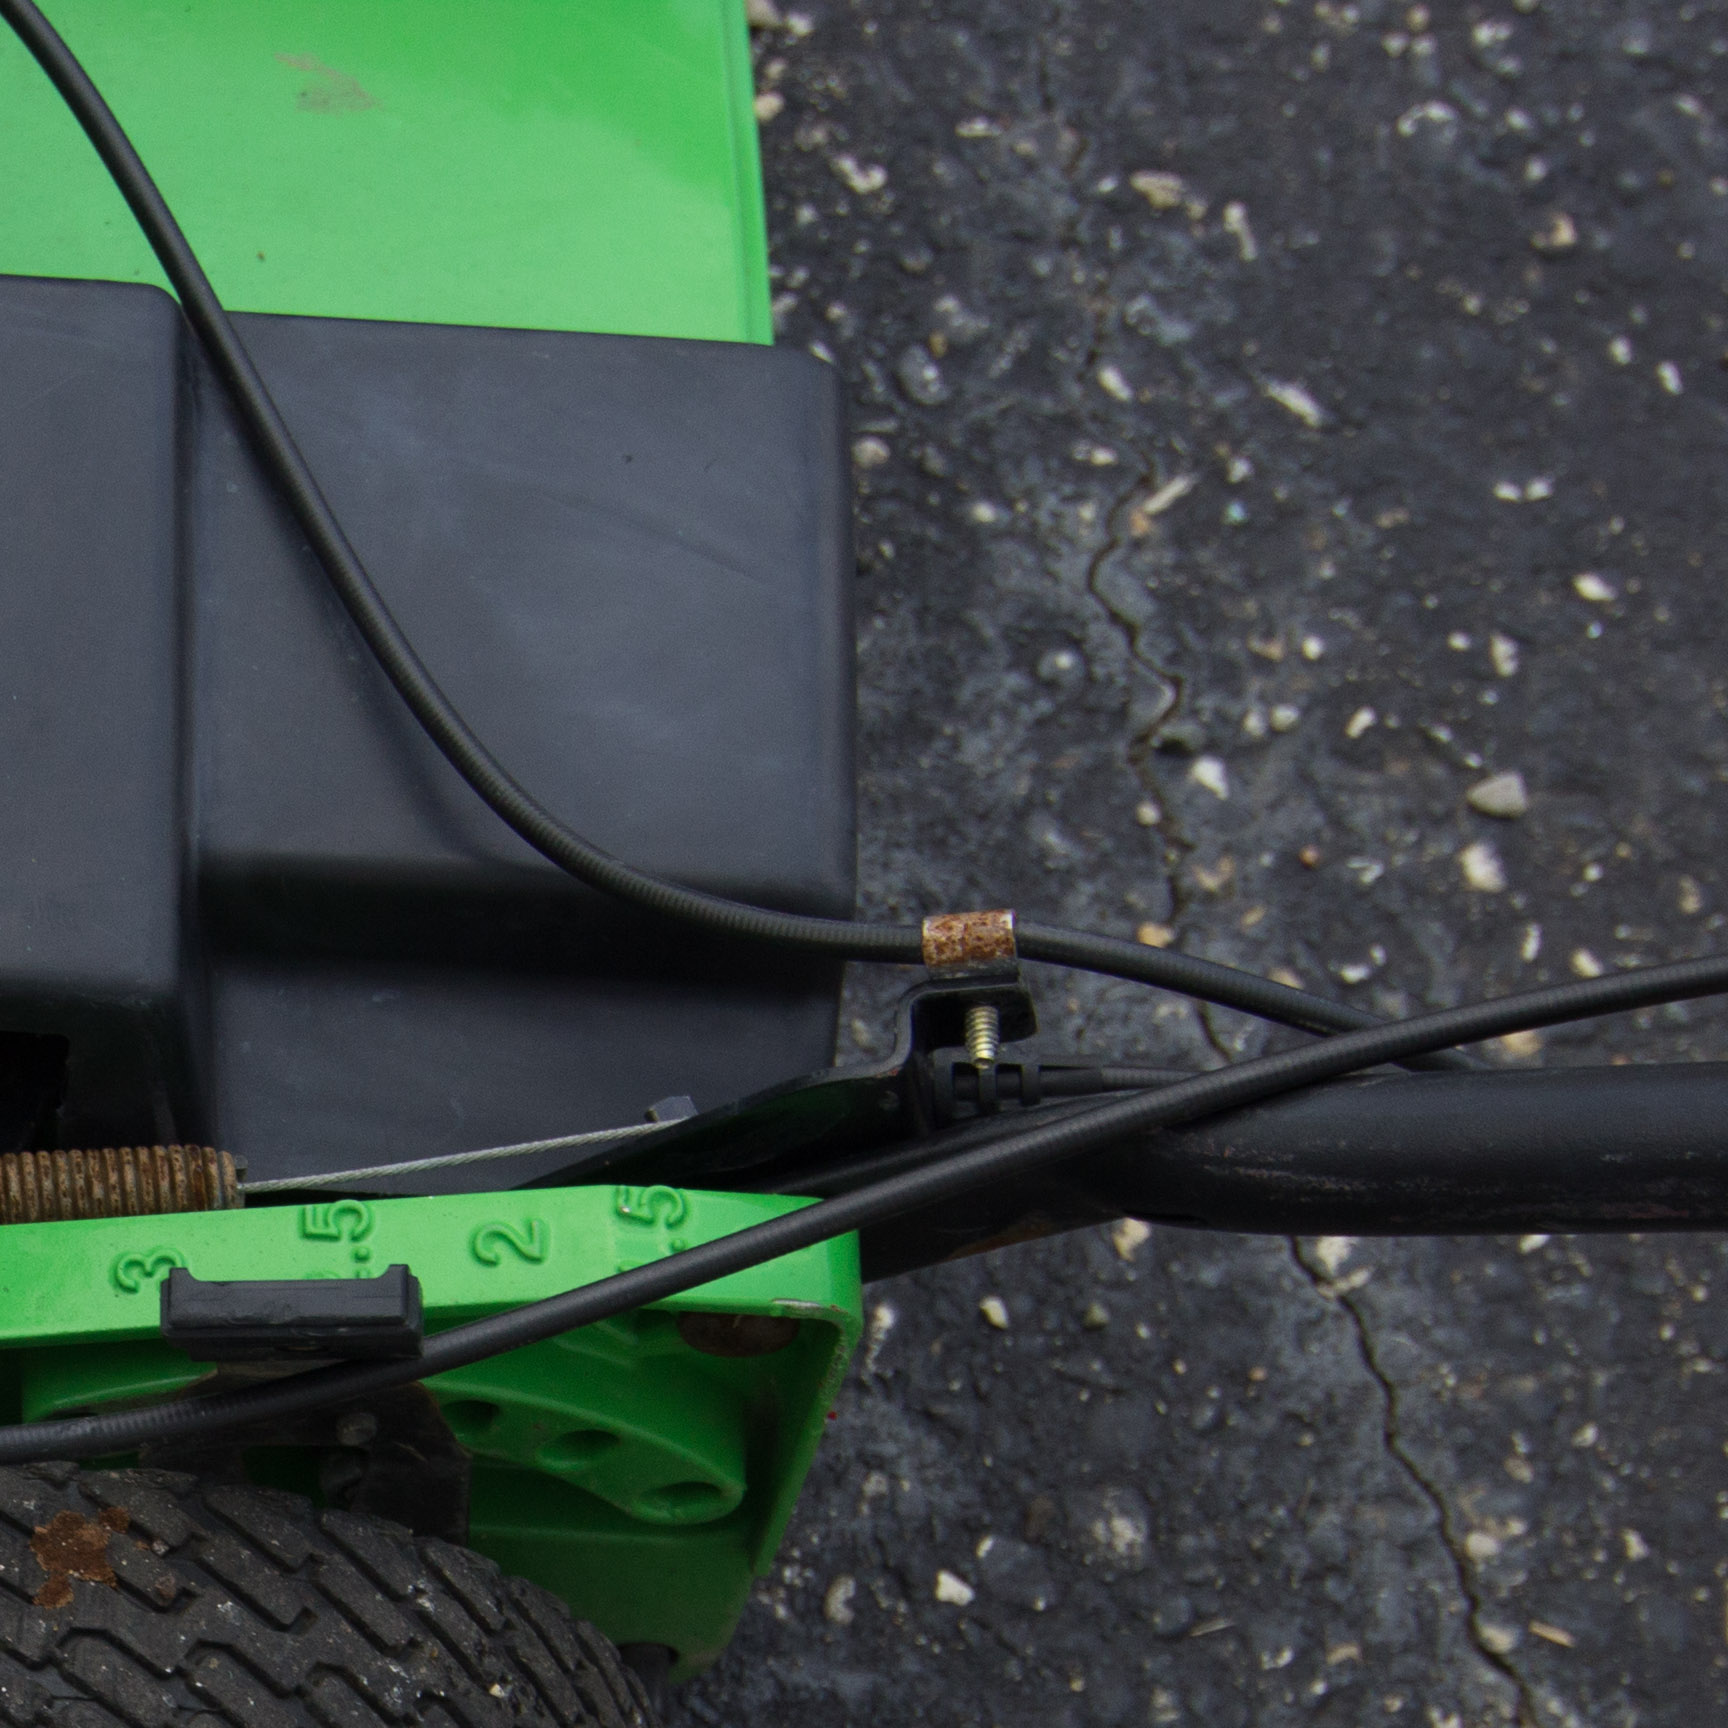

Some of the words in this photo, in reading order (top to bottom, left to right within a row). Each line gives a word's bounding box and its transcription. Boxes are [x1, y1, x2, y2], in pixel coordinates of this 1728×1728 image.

[299, 1199, 373, 1279] .5
[470, 1218, 549, 1268] 2
[615, 1185, 688, 1273] .5
[112, 1247, 186, 1294] 3
